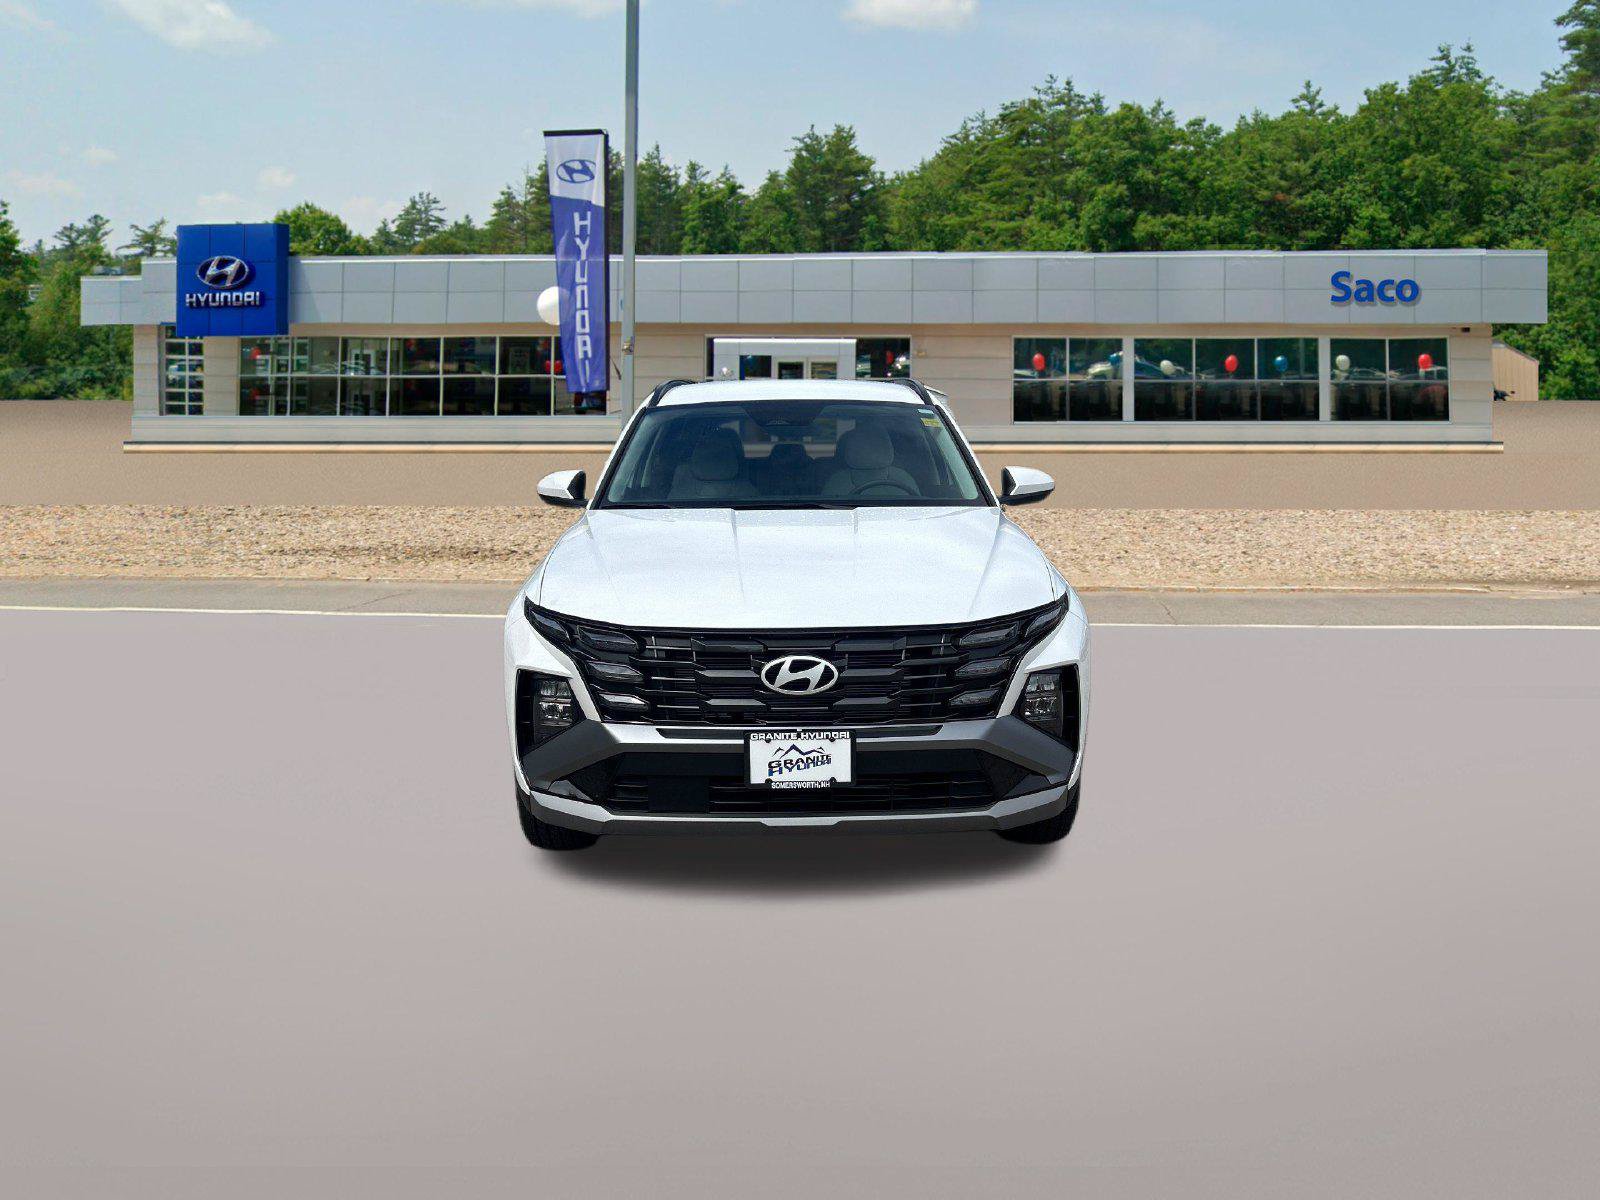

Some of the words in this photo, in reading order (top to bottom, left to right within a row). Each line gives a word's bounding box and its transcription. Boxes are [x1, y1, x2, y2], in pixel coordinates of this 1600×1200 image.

[1330, 270, 1420, 303] Saco
[185, 291, 260, 307] HYUNDAI
[574, 211, 592, 384] HYUNDAI
[750, 732, 798, 740] GRANITE
[801, 731, 850, 740] HYUNDAI
[768, 754, 832, 769] GRANITE
